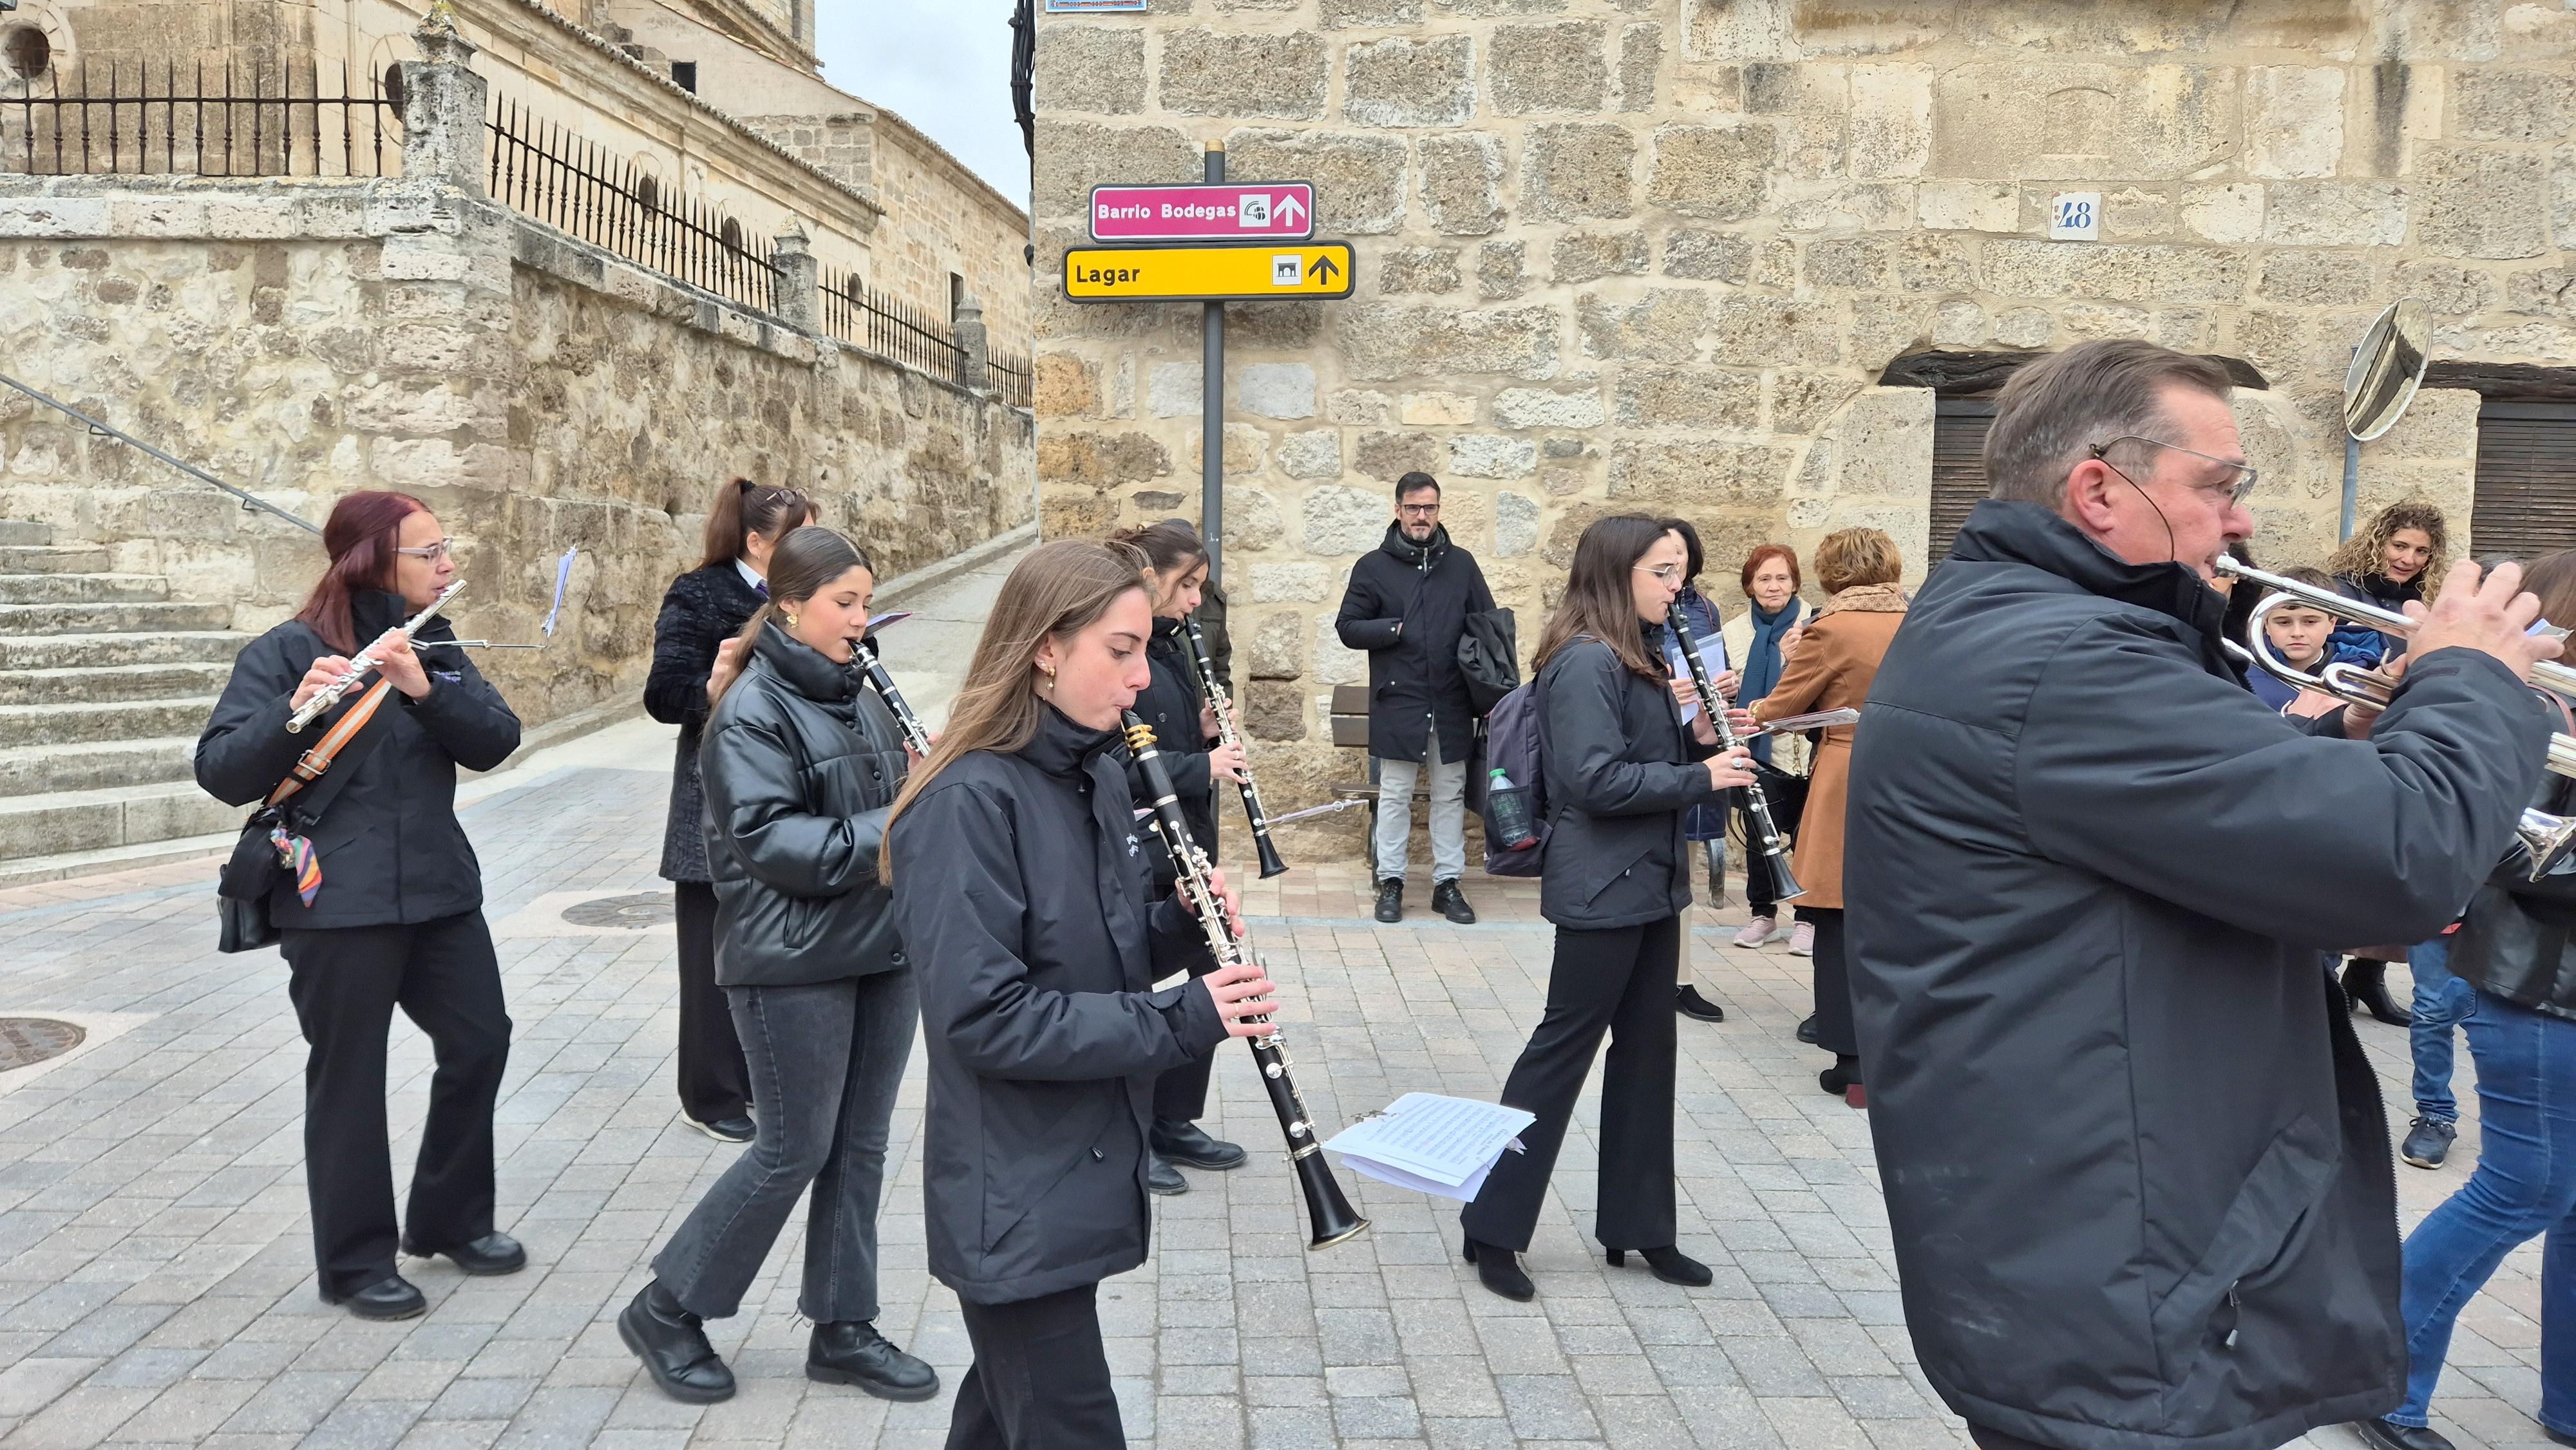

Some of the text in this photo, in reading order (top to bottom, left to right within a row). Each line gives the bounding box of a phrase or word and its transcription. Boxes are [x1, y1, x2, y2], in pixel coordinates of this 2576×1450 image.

[1098, 203, 1236, 220] Barrio Bodegas
[2057, 202, 2091, 229] 48
[1076, 265, 1141, 287] Lagar
